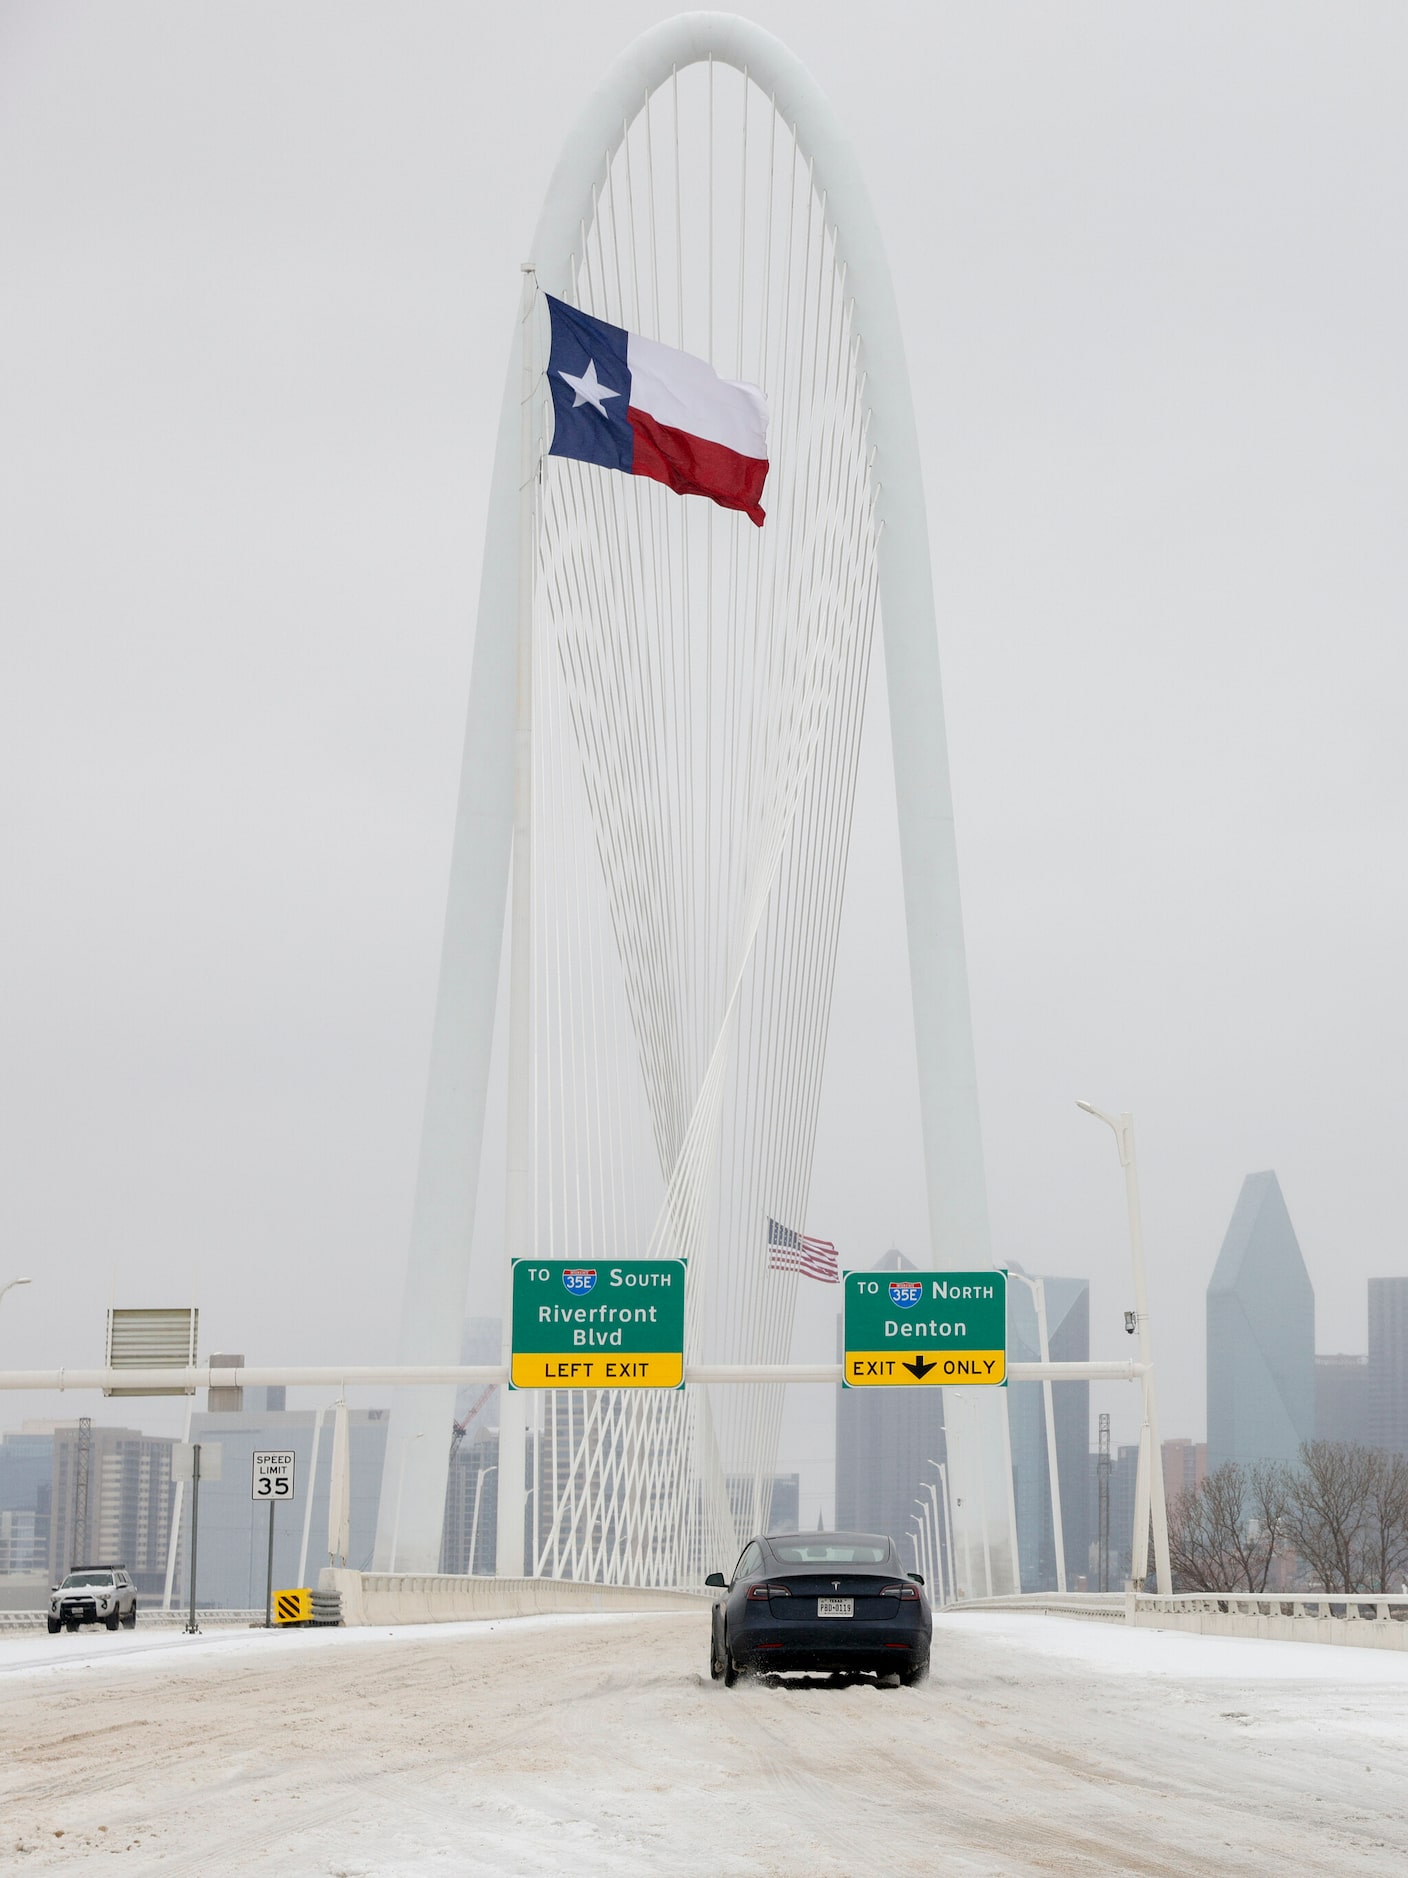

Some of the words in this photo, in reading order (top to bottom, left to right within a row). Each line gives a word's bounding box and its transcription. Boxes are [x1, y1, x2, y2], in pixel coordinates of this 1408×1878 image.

[528, 1268, 551, 1282] TO
[566, 1276, 592, 1289] 35E
[609, 1268, 671, 1287] SOUTH
[857, 1281, 879, 1295] TO
[892, 1289, 918, 1302] 35E
[932, 1281, 993, 1299] NORTH
[538, 1305, 657, 1323] Riverfront
[573, 1328, 622, 1346] Blvd
[884, 1320, 967, 1337] Denton
[545, 1363, 594, 1377] LEFT
[606, 1363, 649, 1377] EXIT
[853, 1361, 896, 1375] EXIT
[943, 1360, 996, 1375] ONLY
[256, 1455, 292, 1464] SPEED
[259, 1466, 287, 1475] LIMIT
[257, 1477, 289, 1495] 35
